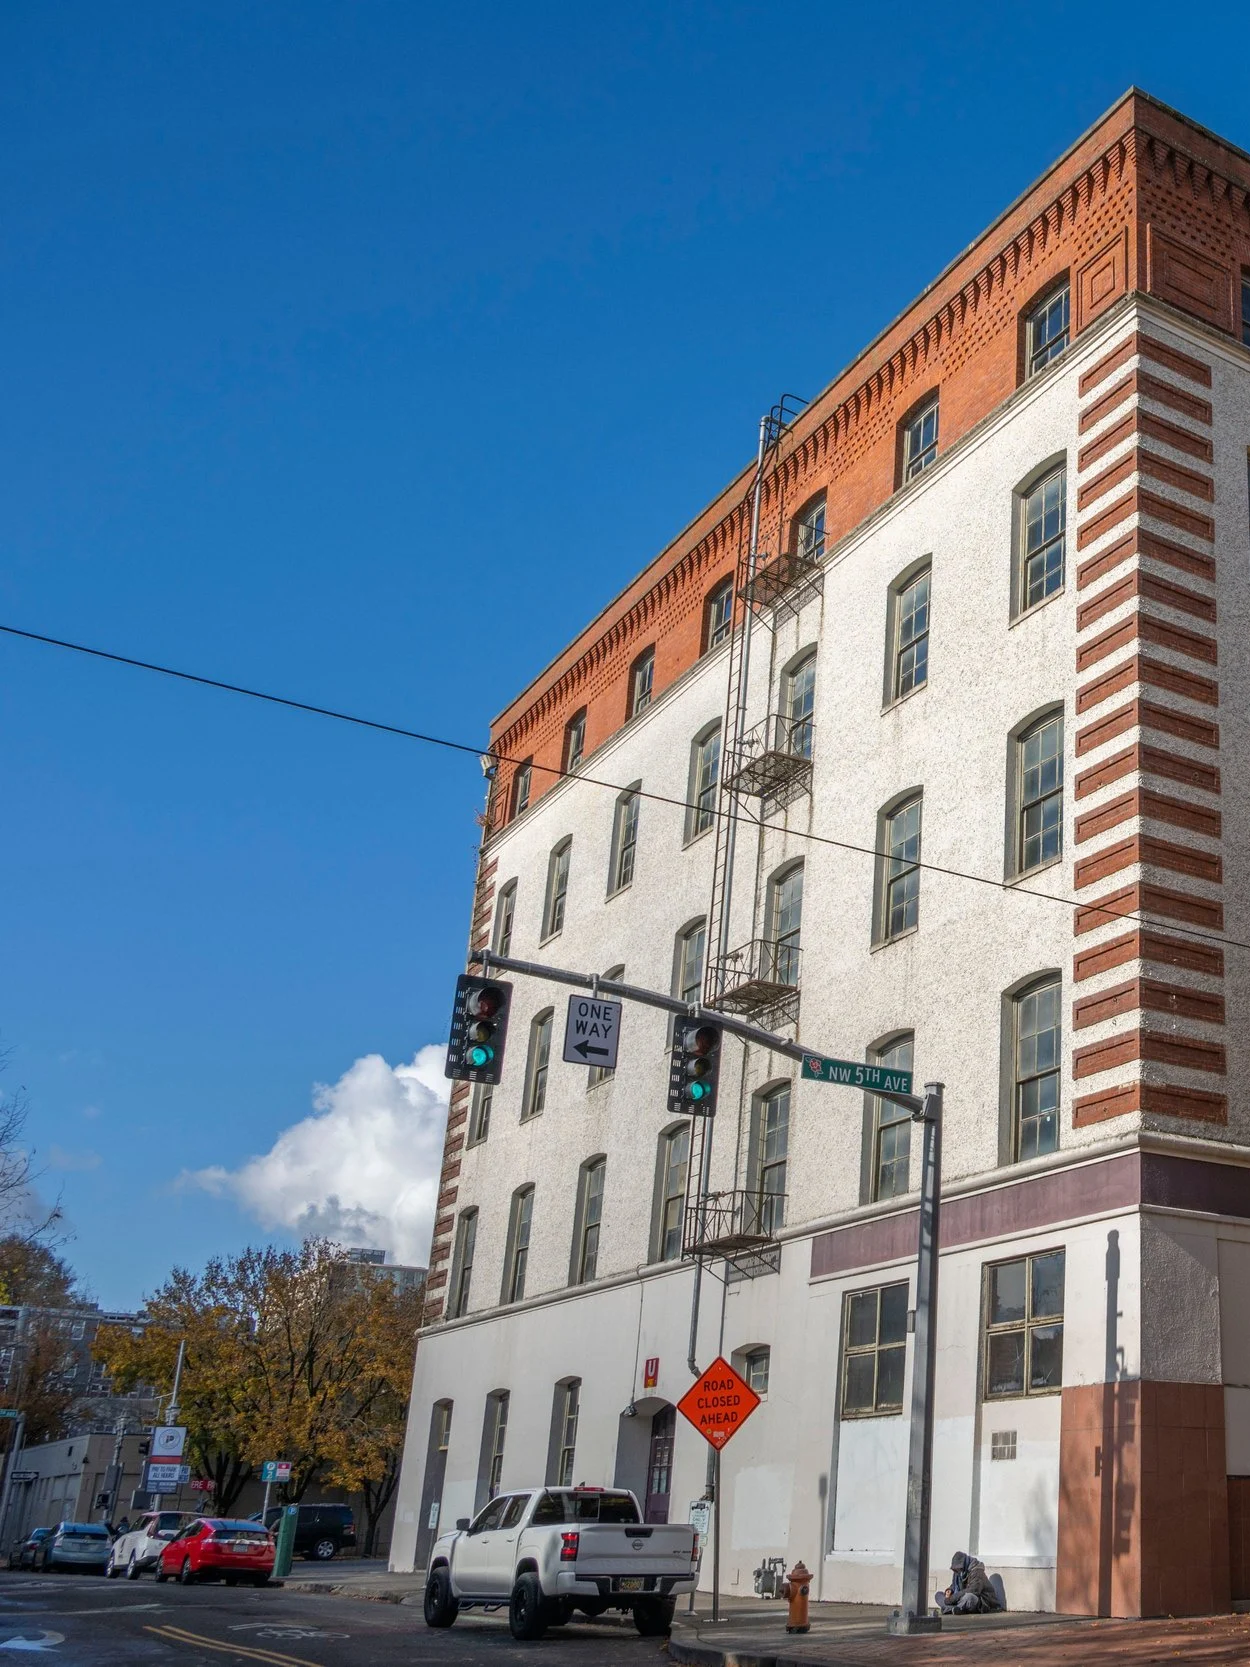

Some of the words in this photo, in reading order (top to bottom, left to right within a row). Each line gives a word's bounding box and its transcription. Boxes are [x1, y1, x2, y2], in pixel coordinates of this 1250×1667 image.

[579, 1003, 613, 1021] ONE
[576, 1019, 612, 1038] WAY
[829, 1066, 851, 1082] NW
[855, 1067, 880, 1084] 5TH
[884, 1076, 907, 1091] AVE
[704, 1379, 734, 1392] ROAD
[697, 1395, 740, 1409] CLOSED
[700, 1411, 738, 1425] AHEAD
